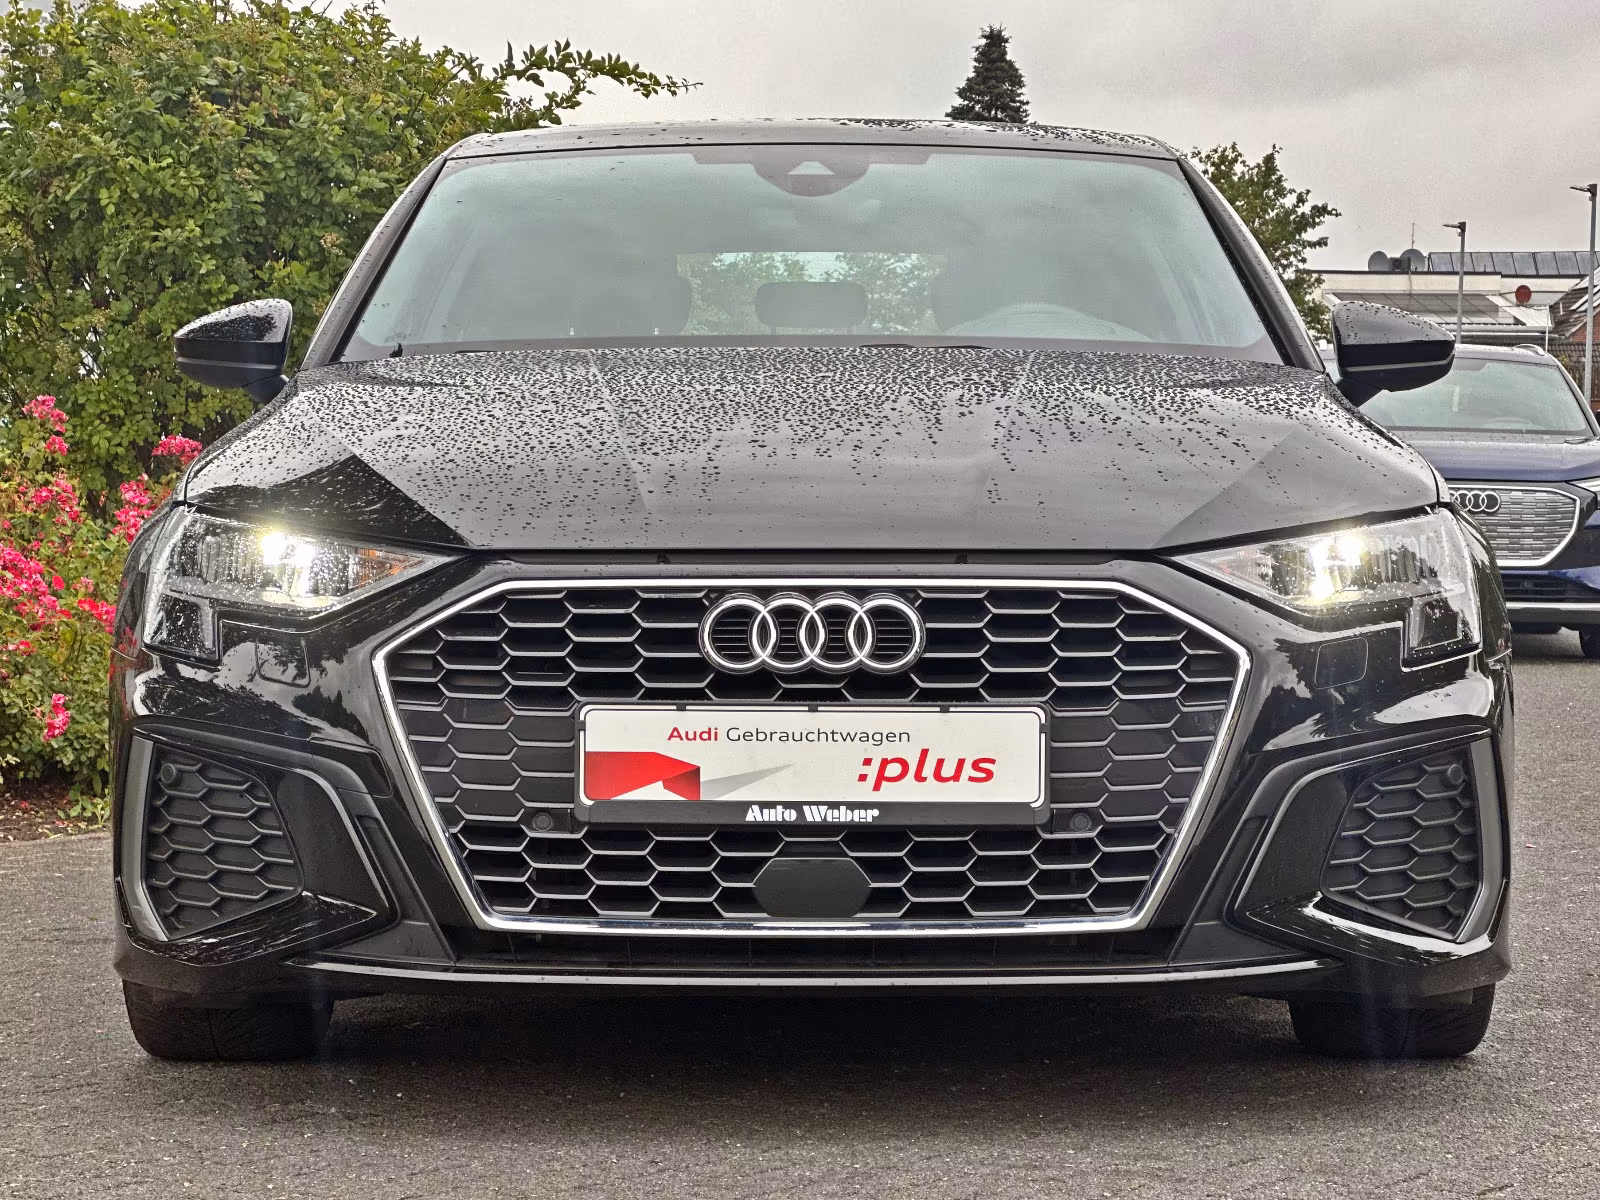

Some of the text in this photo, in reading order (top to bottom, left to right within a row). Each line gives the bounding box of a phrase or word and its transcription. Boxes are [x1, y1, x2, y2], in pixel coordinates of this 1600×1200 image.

[667, 727, 911, 746] Audi Gebrauchtwagen
[745, 804, 880, 823] Auto Weber
